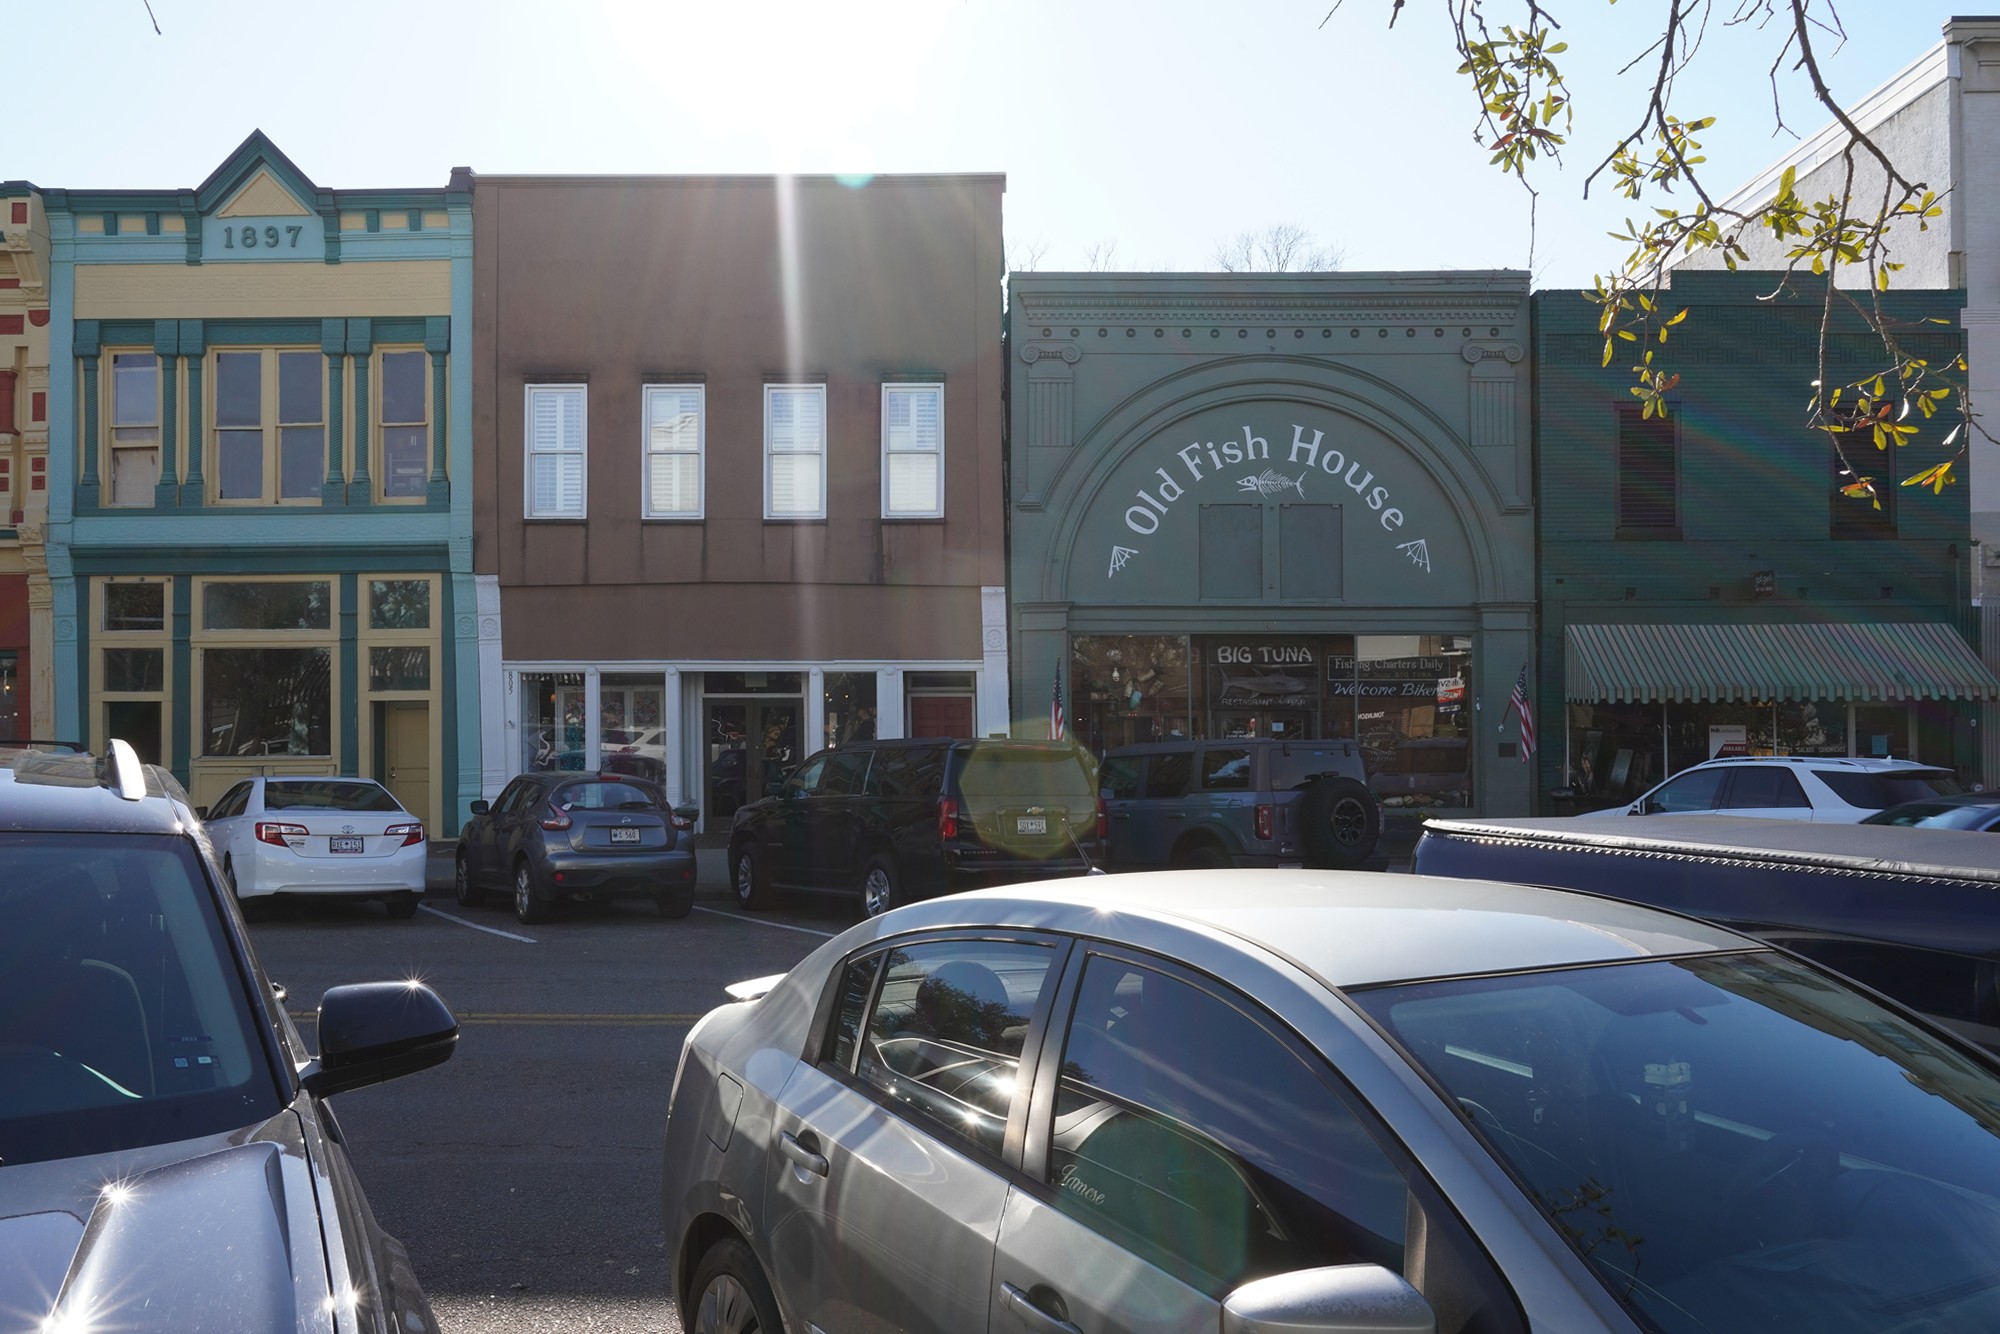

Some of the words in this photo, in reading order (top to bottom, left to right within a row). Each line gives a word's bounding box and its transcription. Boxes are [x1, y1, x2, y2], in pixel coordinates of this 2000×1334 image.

[224, 225, 303, 249] 1897
[1124, 467, 1185, 535] Old
[1177, 425, 1270, 482] Fish
[1287, 424, 1404, 532] House
[1217, 646, 1253, 663] BIG
[1257, 646, 1313, 663] TUNA
[1334, 657, 1371, 672] Fishng
[1374, 658, 1417, 670] Charters
[1420, 657, 1444, 672] Daily
[1334, 682, 1397, 696] Welcome
[625, 831, 636, 839] 560
[332, 840, 344, 849] RXE
[350, 840, 361, 849] 151
